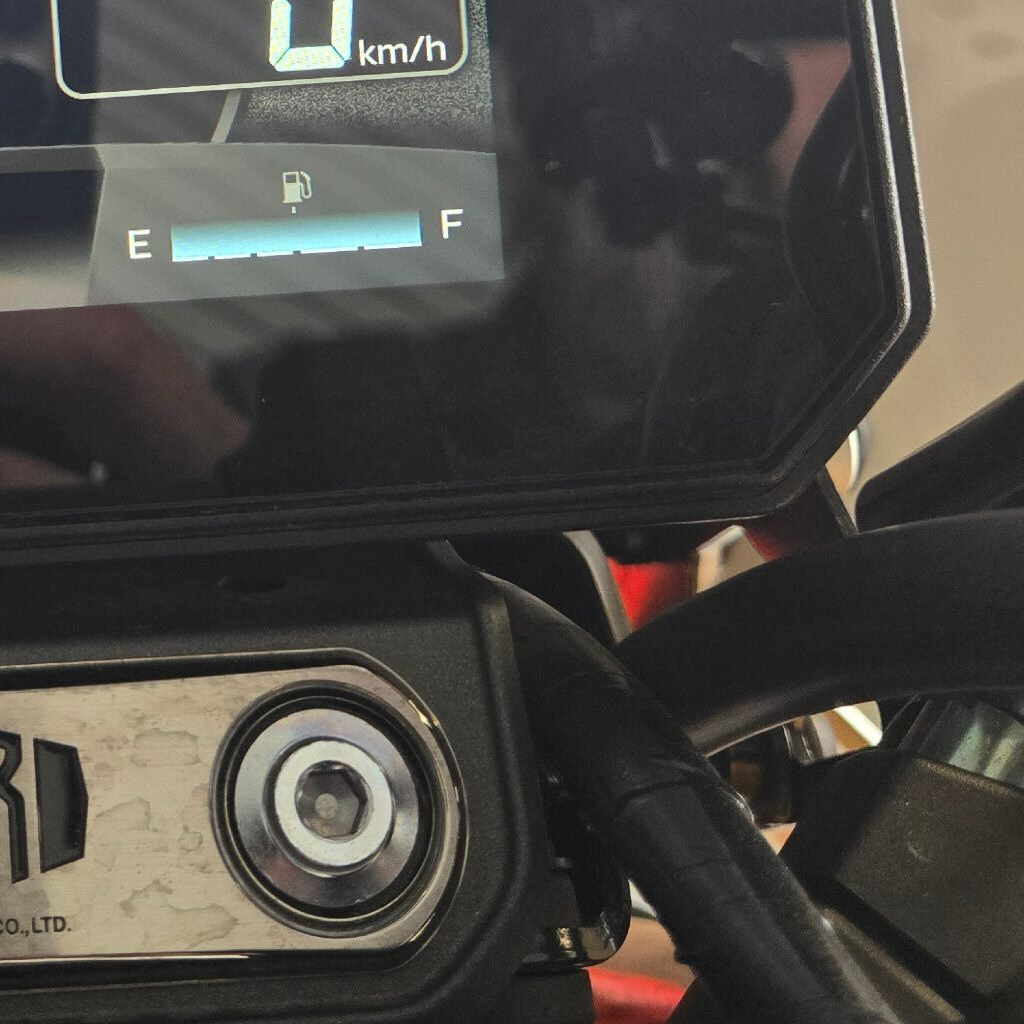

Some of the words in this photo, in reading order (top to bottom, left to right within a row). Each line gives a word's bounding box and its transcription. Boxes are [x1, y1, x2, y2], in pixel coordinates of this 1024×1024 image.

[358, 35, 448, 67] km/h
[440, 208, 464, 239] F
[127, 229, 152, 260] E
